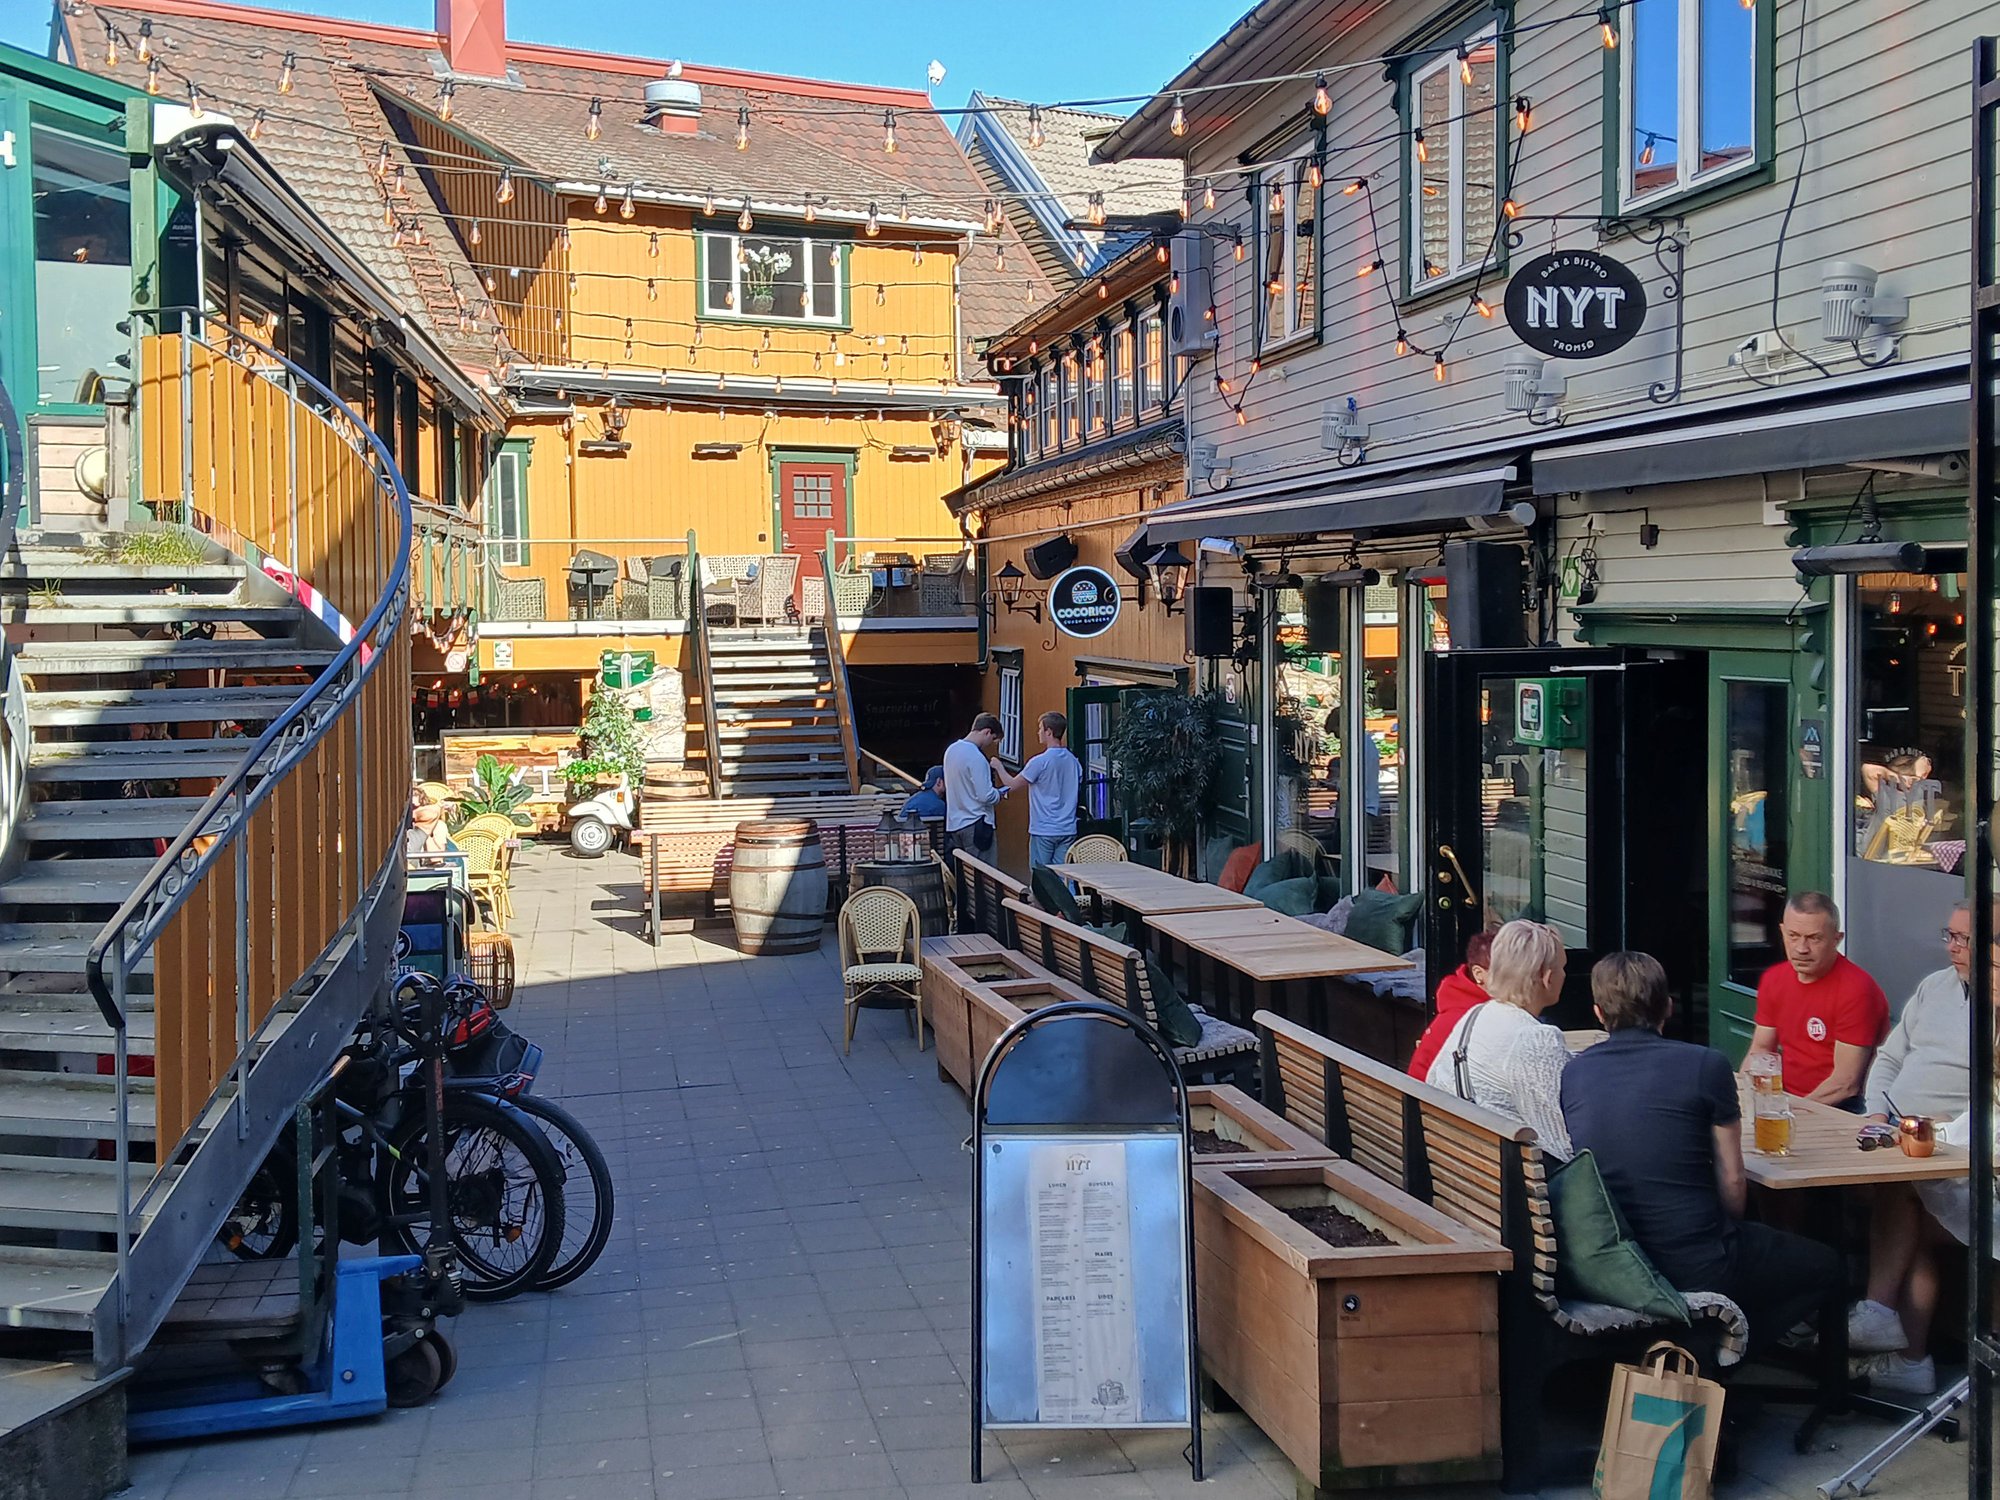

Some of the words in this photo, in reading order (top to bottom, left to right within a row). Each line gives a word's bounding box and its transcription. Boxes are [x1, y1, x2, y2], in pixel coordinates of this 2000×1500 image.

[1540, 261, 1560, 278] BAR
[1563, 257, 1570, 266] &
[1573, 257, 1608, 278] BISTRO
[1526, 286, 1625, 328] NYT
[1553, 339, 1594, 352] TROMSØ
[1057, 605, 1115, 618] COCORICO
